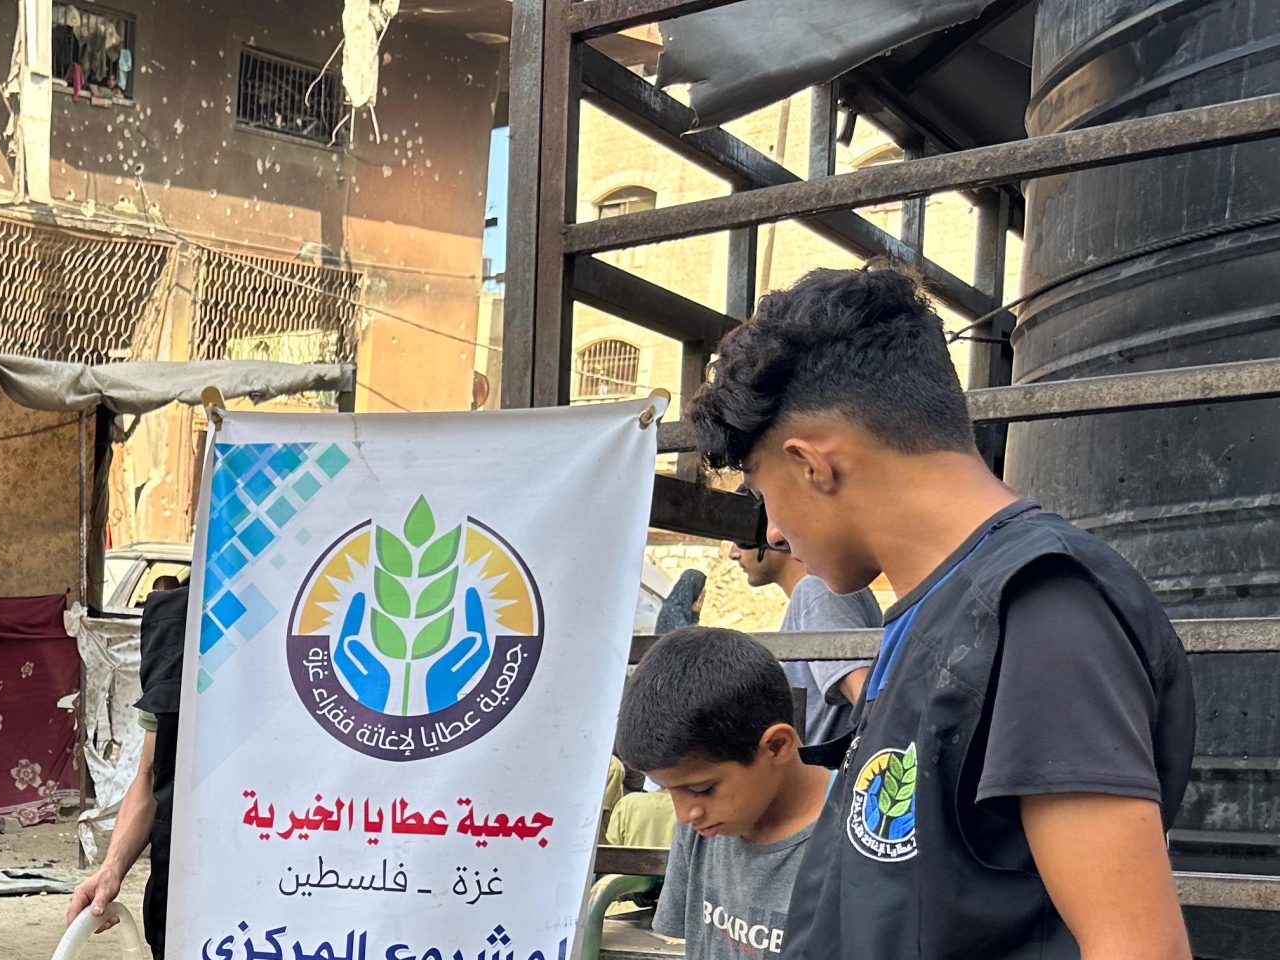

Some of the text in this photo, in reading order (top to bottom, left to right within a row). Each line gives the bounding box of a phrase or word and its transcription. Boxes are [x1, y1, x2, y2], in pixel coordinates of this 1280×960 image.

[302, 643, 529, 756] جمعية عطايا لإغاثة فقراء غزة
[242, 790, 554, 848] جمعية عطايا الخيرية
[278, 855, 408, 897] فلسطين
[452, 866, 504, 905] غزة
